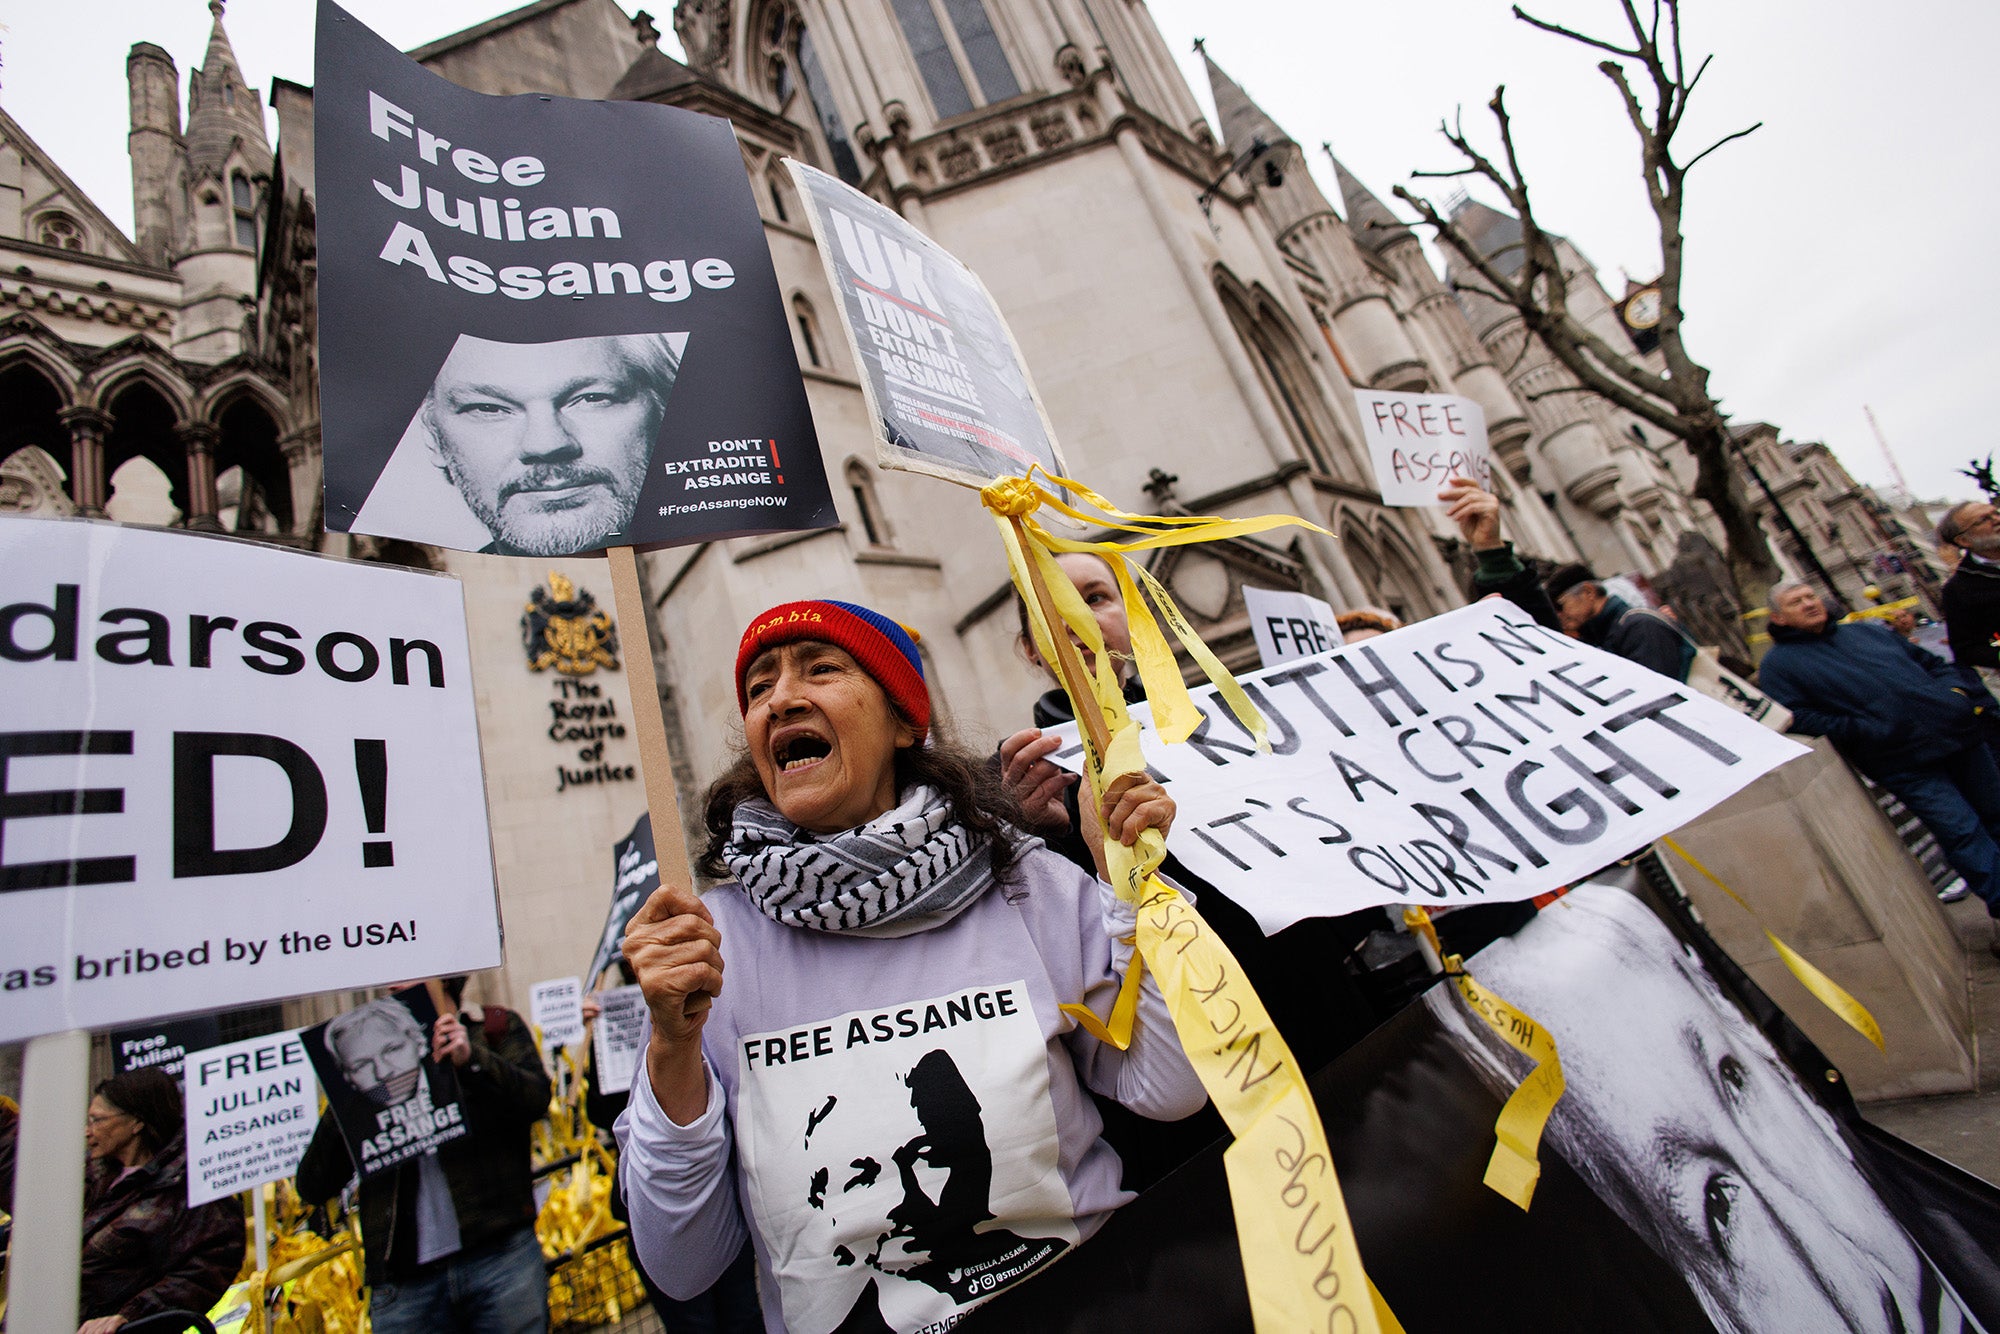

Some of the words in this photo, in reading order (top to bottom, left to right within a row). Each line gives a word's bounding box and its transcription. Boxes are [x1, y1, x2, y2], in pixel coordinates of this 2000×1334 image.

[369, 90, 546, 187] Free
[372, 164, 622, 242] Julian
[379, 220, 736, 303] Assange
[829, 207, 946, 318] UK
[855, 286, 961, 359] DON'T
[867, 325, 972, 382] EXTRADITE
[878, 349, 983, 407] ASSANGE
[1372, 401, 1466, 438] FREE
[664, 455, 768, 475] EXTRADITE
[708, 439, 762, 453] DON'T
[684, 472, 772, 491] ASSANGE
[658, 496, 788, 517] #FreeAssangeNOW
[0, 583, 446, 689] darson
[549, 698, 616, 723] Royal
[553, 678, 600, 699] The
[548, 721, 626, 742] Courts
[579, 740, 604, 762] of
[557, 763, 635, 792] Justice
[1190, 796, 1352, 872] IT'S
[1329, 750, 1399, 802] A
[1398, 662, 1635, 783] CRIME
[1410, 693, 1742, 881] RIGHT
[1347, 839, 1485, 899] OUR
[0, 963, 57, 991] as
[75, 940, 211, 981] bribed
[225, 935, 268, 965] by
[280, 931, 332, 956] the
[342, 919, 418, 949] USA!
[122, 1034, 168, 1057] Free
[743, 1025, 834, 1072] FREE
[845, 988, 1018, 1050] ASSANGE
[124, 1045, 186, 1072] Julian
[199, 1040, 304, 1087] FREE
[204, 1077, 302, 1117] JULIAN
[204, 1105, 306, 1146] ASSANGE
[361, 1101, 463, 1161] ASSANGE
